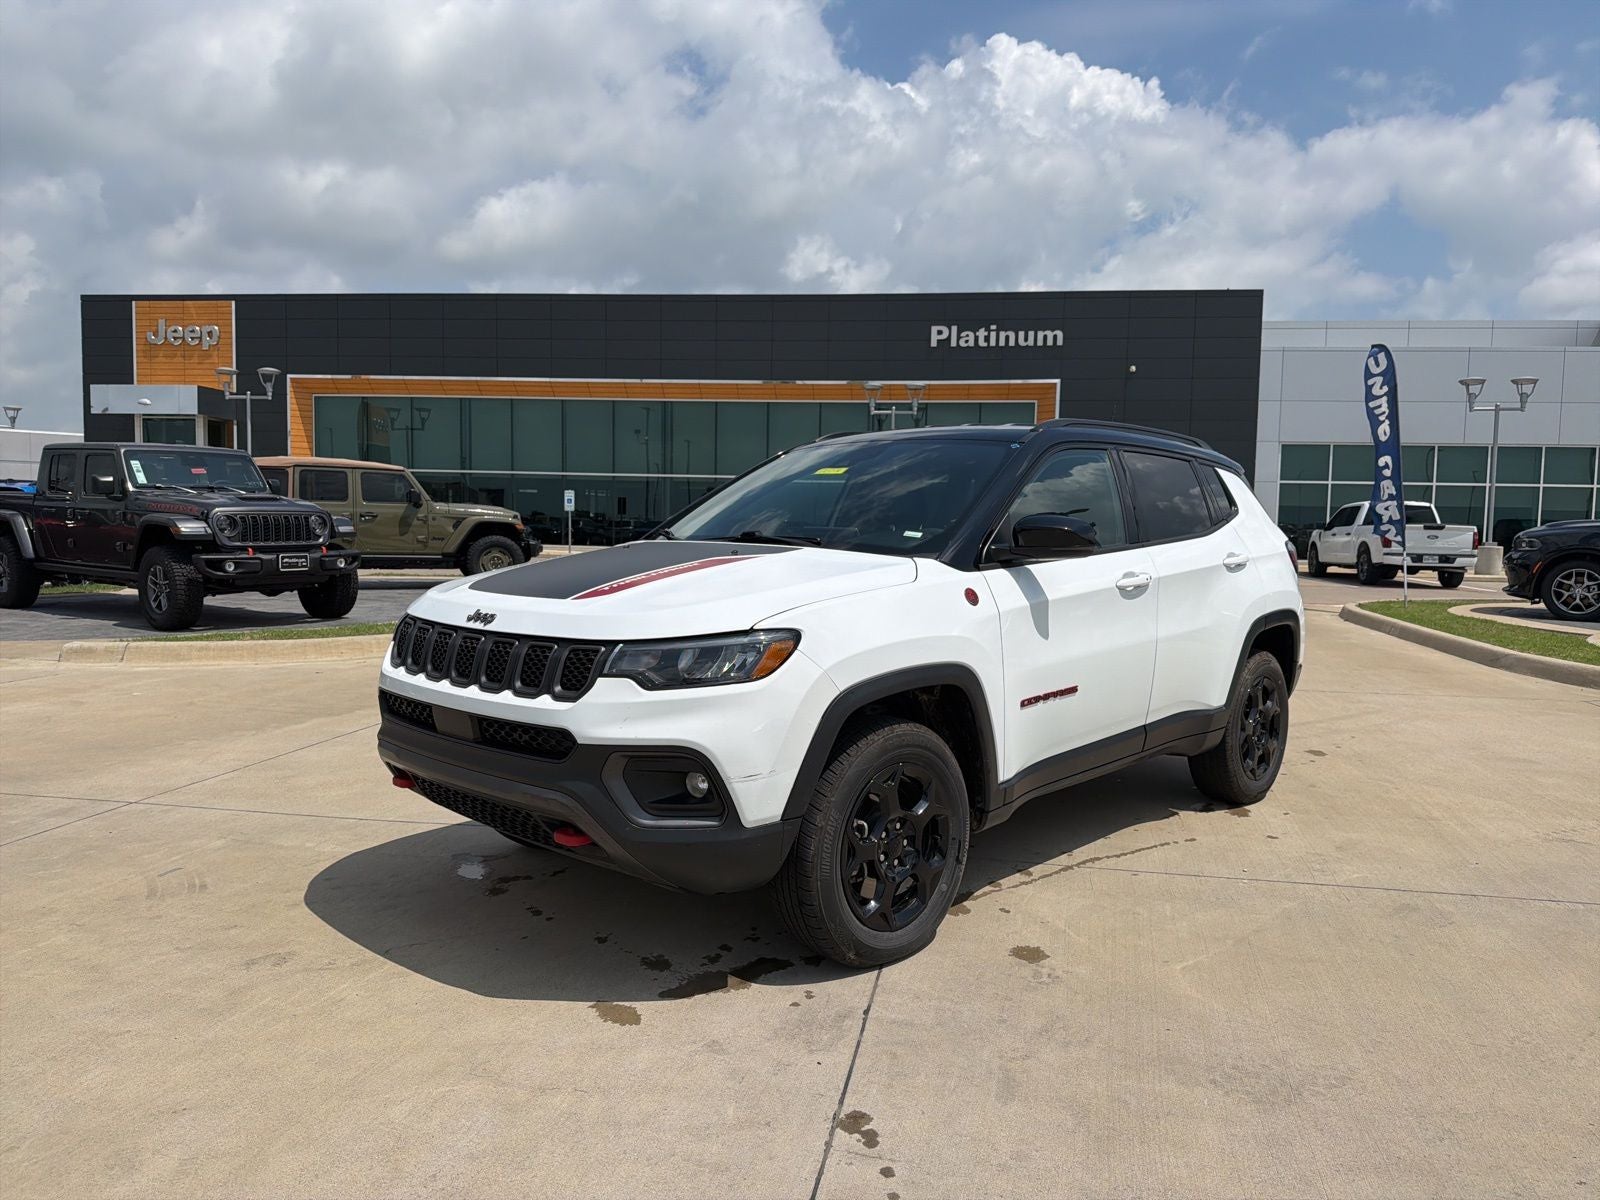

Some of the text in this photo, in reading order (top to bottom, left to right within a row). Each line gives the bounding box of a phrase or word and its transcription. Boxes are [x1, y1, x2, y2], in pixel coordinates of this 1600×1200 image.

[146, 318, 220, 350] Jeep
[930, 324, 1064, 347] Platinum
[466, 609, 497, 626] Jeep
[1020, 685, 1079, 708] COMPASS
